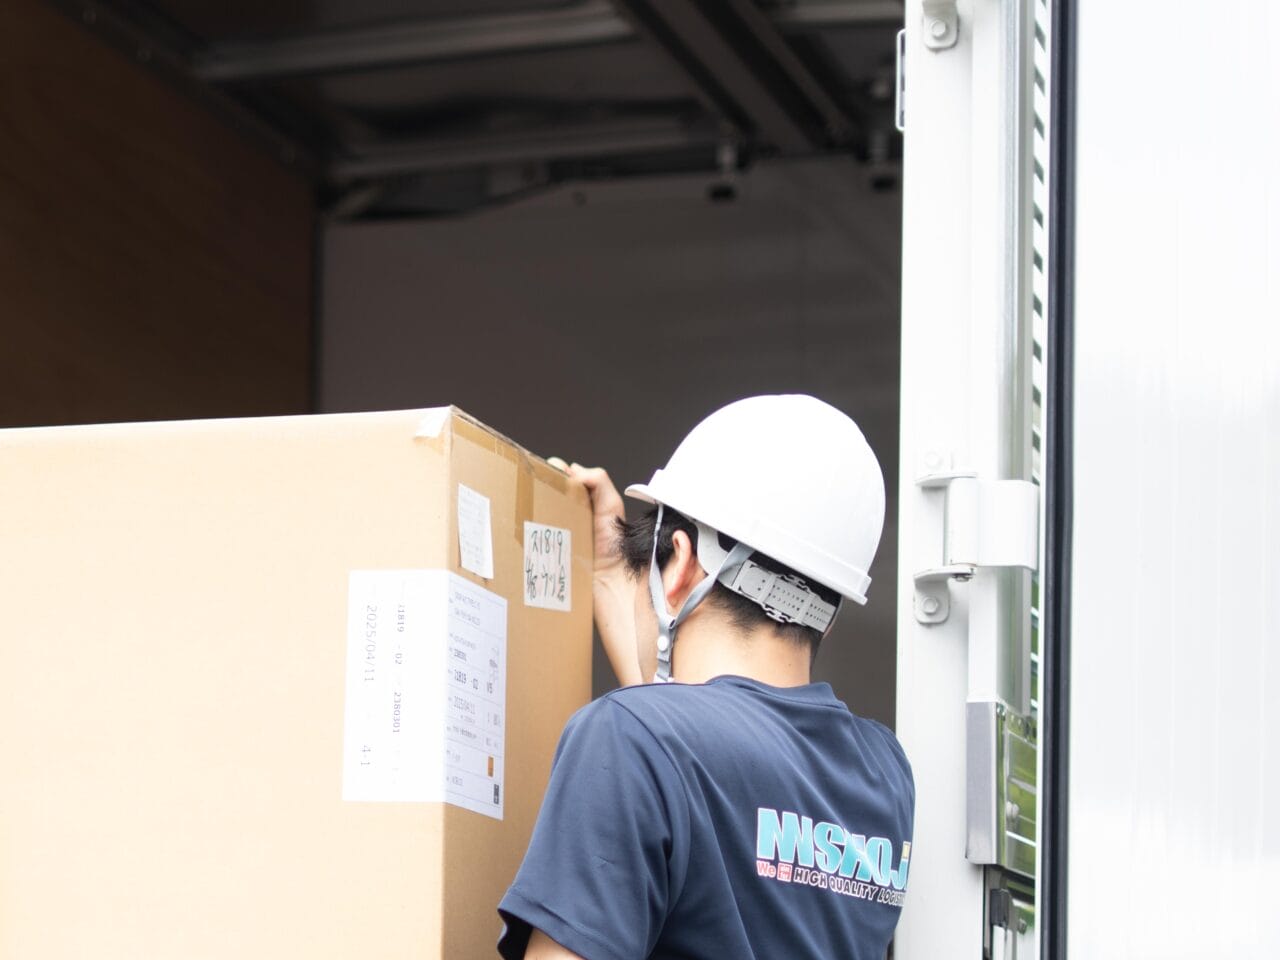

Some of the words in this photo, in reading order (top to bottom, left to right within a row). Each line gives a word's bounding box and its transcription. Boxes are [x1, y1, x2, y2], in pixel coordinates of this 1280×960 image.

[363, 604, 378, 682] 2025/04/11
[757, 860, 777, 878] We
[793, 867, 828, 889] HIGH
[829, 876, 879, 901] QUALITY
